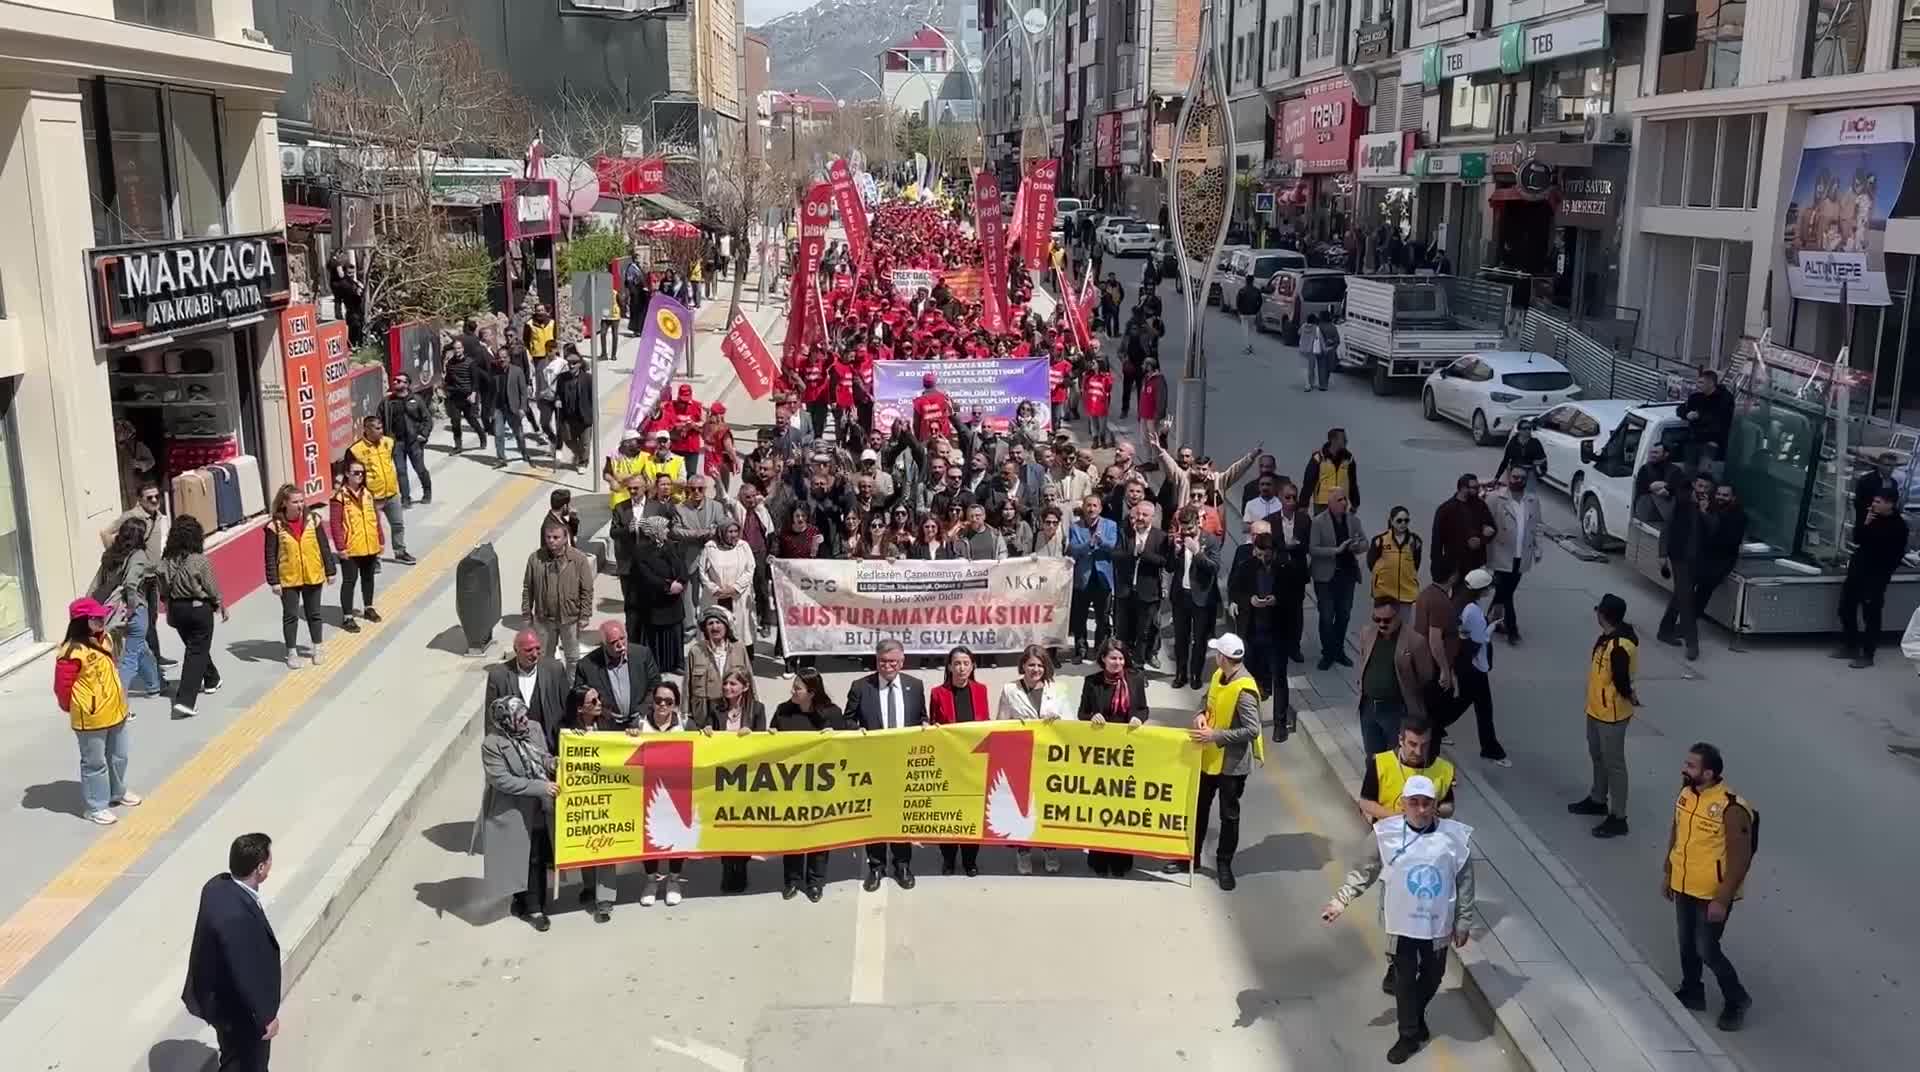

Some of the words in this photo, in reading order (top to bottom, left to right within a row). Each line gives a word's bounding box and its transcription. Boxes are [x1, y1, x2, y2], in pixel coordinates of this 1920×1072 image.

[1532, 34, 1553, 55] TEB
[1446, 55, 1463, 71] TEB
[1310, 101, 1345, 128] TREND
[152, 294, 215, 325] AYAKKABI
[289, 312, 310, 333] YENİ
[288, 339, 315, 357] SEZON
[325, 361, 348, 382] SEZON
[299, 367, 323, 495] İNDİRİM
[787, 603, 1056, 627] SUSTURAMAYACAKSINIZ
[919, 628, 997, 646] GULANÊ
[566, 746, 600, 758] EMEK
[908, 745, 918, 755] JI
[919, 744, 935, 755] BO
[1047, 744, 1070, 762] DI
[1078, 744, 1135, 767] YEKÊ
[566, 762, 601, 773] BARIŞ
[906, 755, 936, 767] KEDÊ
[904, 780, 949, 793] AZADIYÊ
[1046, 774, 1136, 799] GULANÊ
[1143, 781, 1173, 802] DE
[566, 794, 612, 807] ADALET
[903, 797, 932, 809] DADÊ
[566, 809, 609, 824] EŞİTLİK
[714, 798, 872, 822] ALANLARDAYIZ!
[902, 809, 963, 821] WEKHEVIYÊ
[1043, 803, 1070, 821] EM
[1076, 805, 1093, 823] LI
[1099, 808, 1152, 828] QADÊ
[1159, 813, 1189, 831] NE!
[566, 819, 635, 837] DEMOKRASİ
[901, 824, 977, 835] DEMOKRASIYÊ
